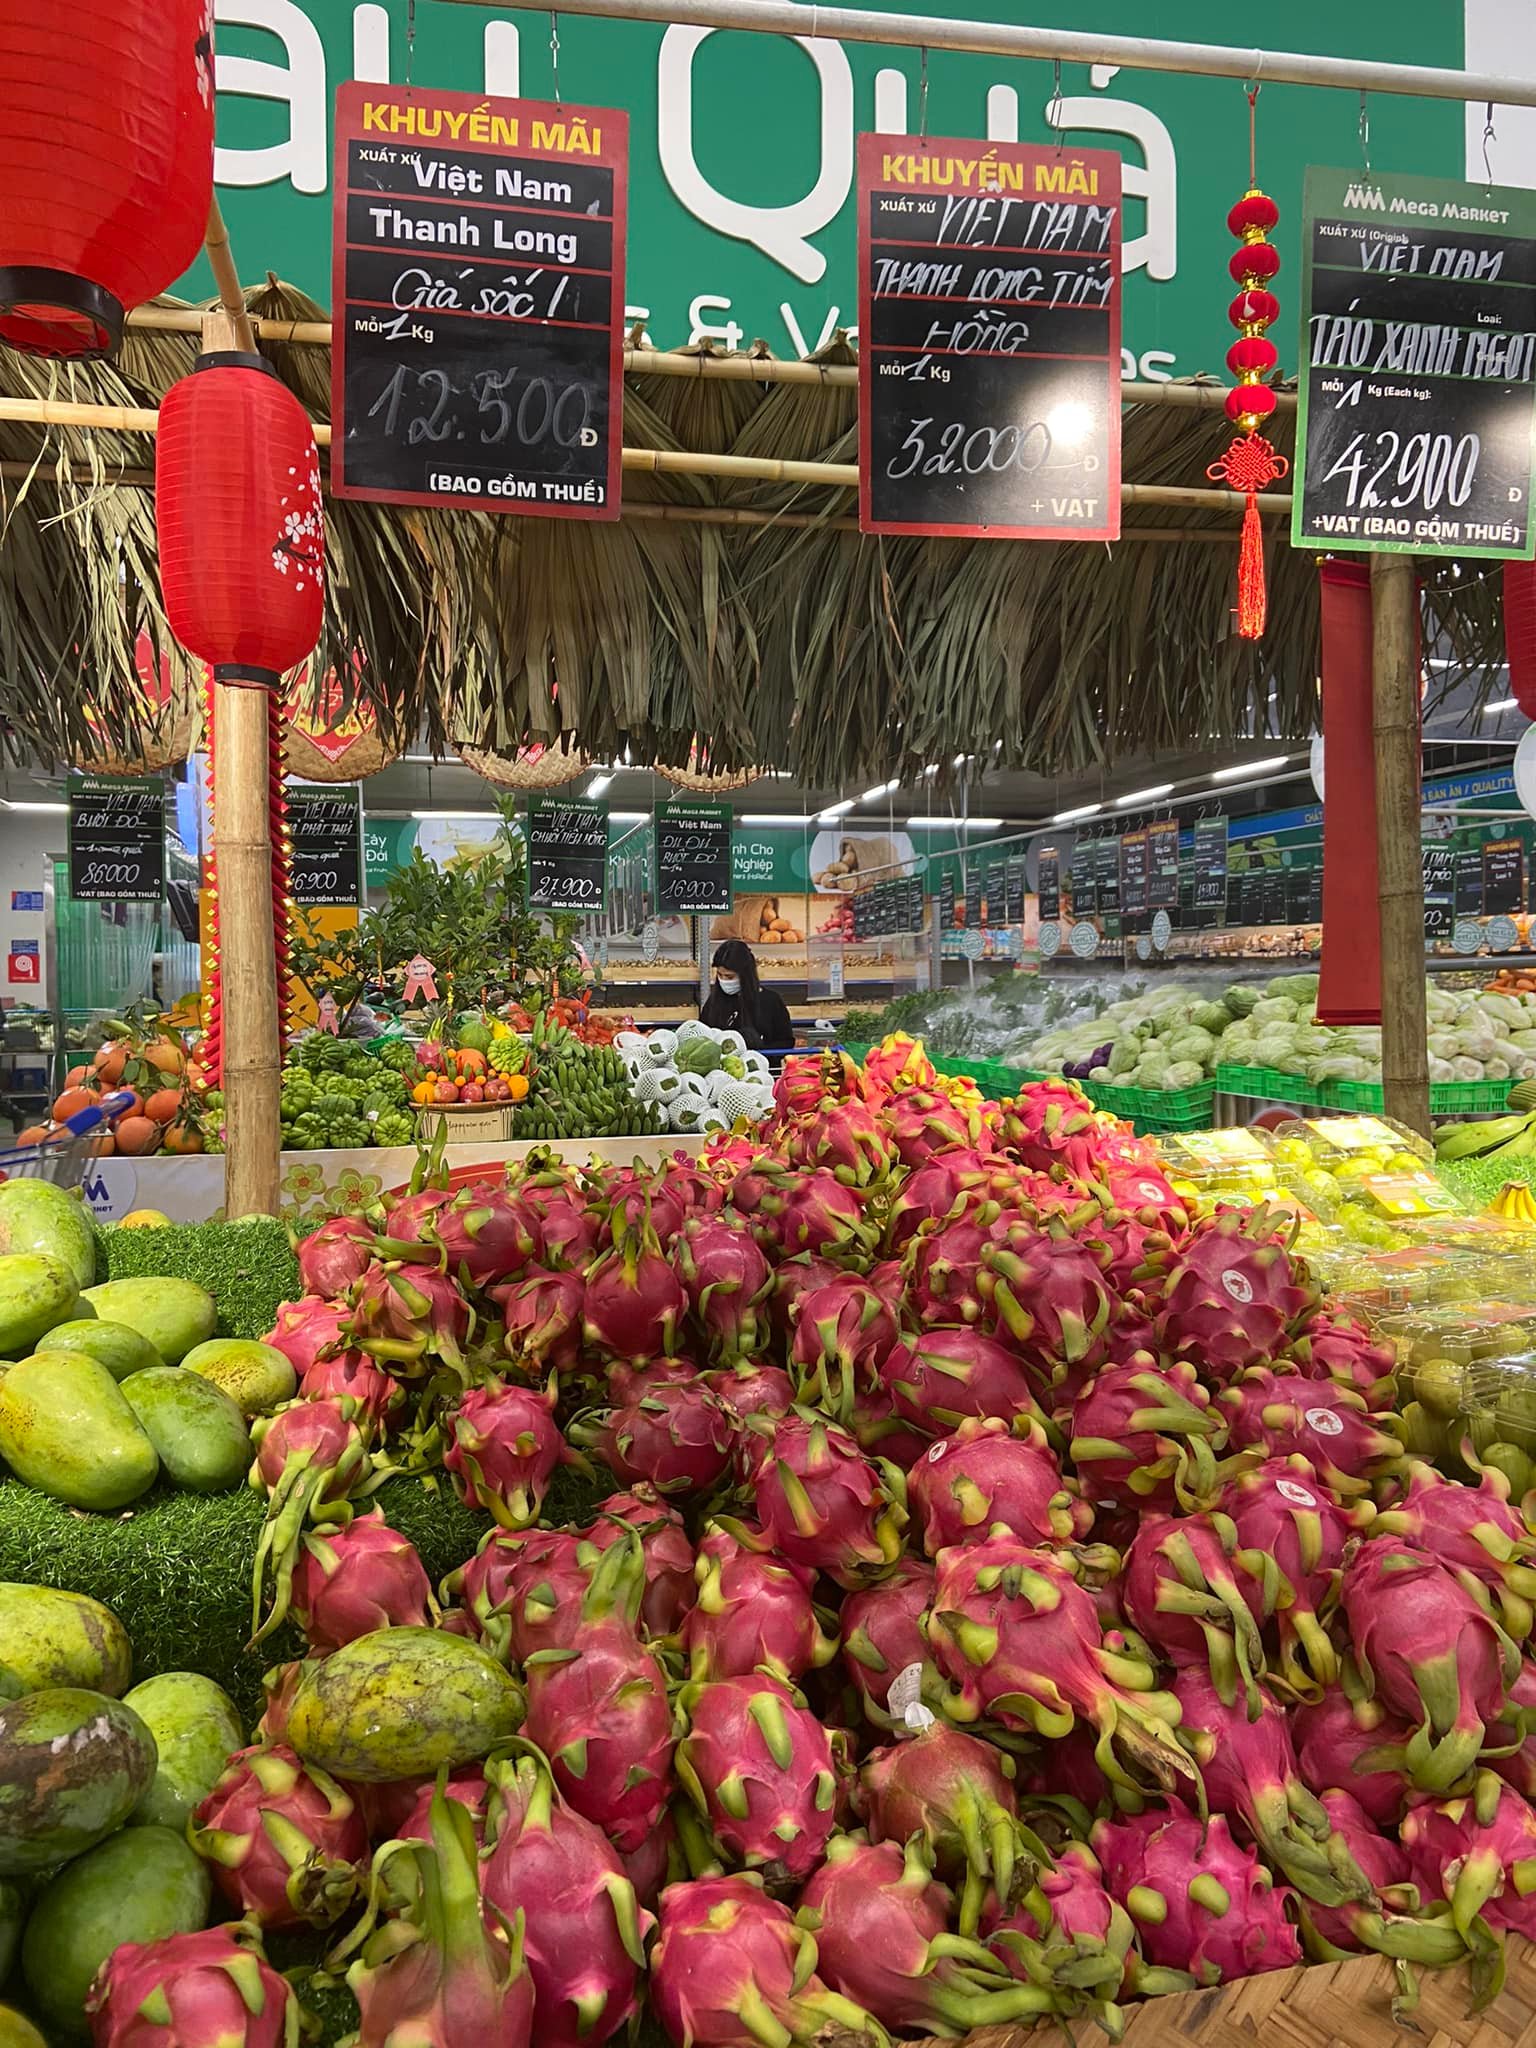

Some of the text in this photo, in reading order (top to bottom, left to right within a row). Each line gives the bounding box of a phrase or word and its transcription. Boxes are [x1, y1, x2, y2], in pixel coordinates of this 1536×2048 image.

[363, 102, 601, 155] KHUYẾN MÃI
[359, 148, 397, 164] XUẤT
[412, 160, 571, 203] Việt Nam
[882, 148, 1098, 196] KHUYẾN MÃI
[880, 198, 936, 215] XUẤT XỨ
[935, 180, 1117, 253] VIỆT NAM
[369, 208, 577, 264] Thanh Long
[1319, 224, 1348, 238] XUẤT
[1350, 225, 1366, 239] XỨ
[1429, 247, 1504, 283] NAM
[392, 268, 474, 312] Giá
[472, 268, 544, 318] sốc
[874, 258, 1114, 310] THANH LONG TÍM
[355, 313, 434, 343] MỖI 1 Kg
[1308, 298, 1372, 368] TÁO
[1372, 323, 1461, 376] XANH
[879, 354, 951, 383] MỖI 1 Kg
[368, 364, 597, 447] 12.500 Đ
[1322, 379, 1432, 409] MỖI 1 Kg (Each kg):
[1082, 455, 1099, 473] Đ
[1322, 430, 1522, 511] 42.900 Đ
[429, 470, 604, 503] (BAO GỒM THUẾ)
[1030, 499, 1098, 518] + VAT
[1312, 511, 1520, 543] +VAT (BAO GỒM THUẾ)
[700, 821, 722, 829] Nam
[733, 843, 774, 855] nh Cho
[80, 862, 140, 885] 86.000
[734, 858, 773, 873] Nghiệp
[534, 876, 593, 897] 27.900
